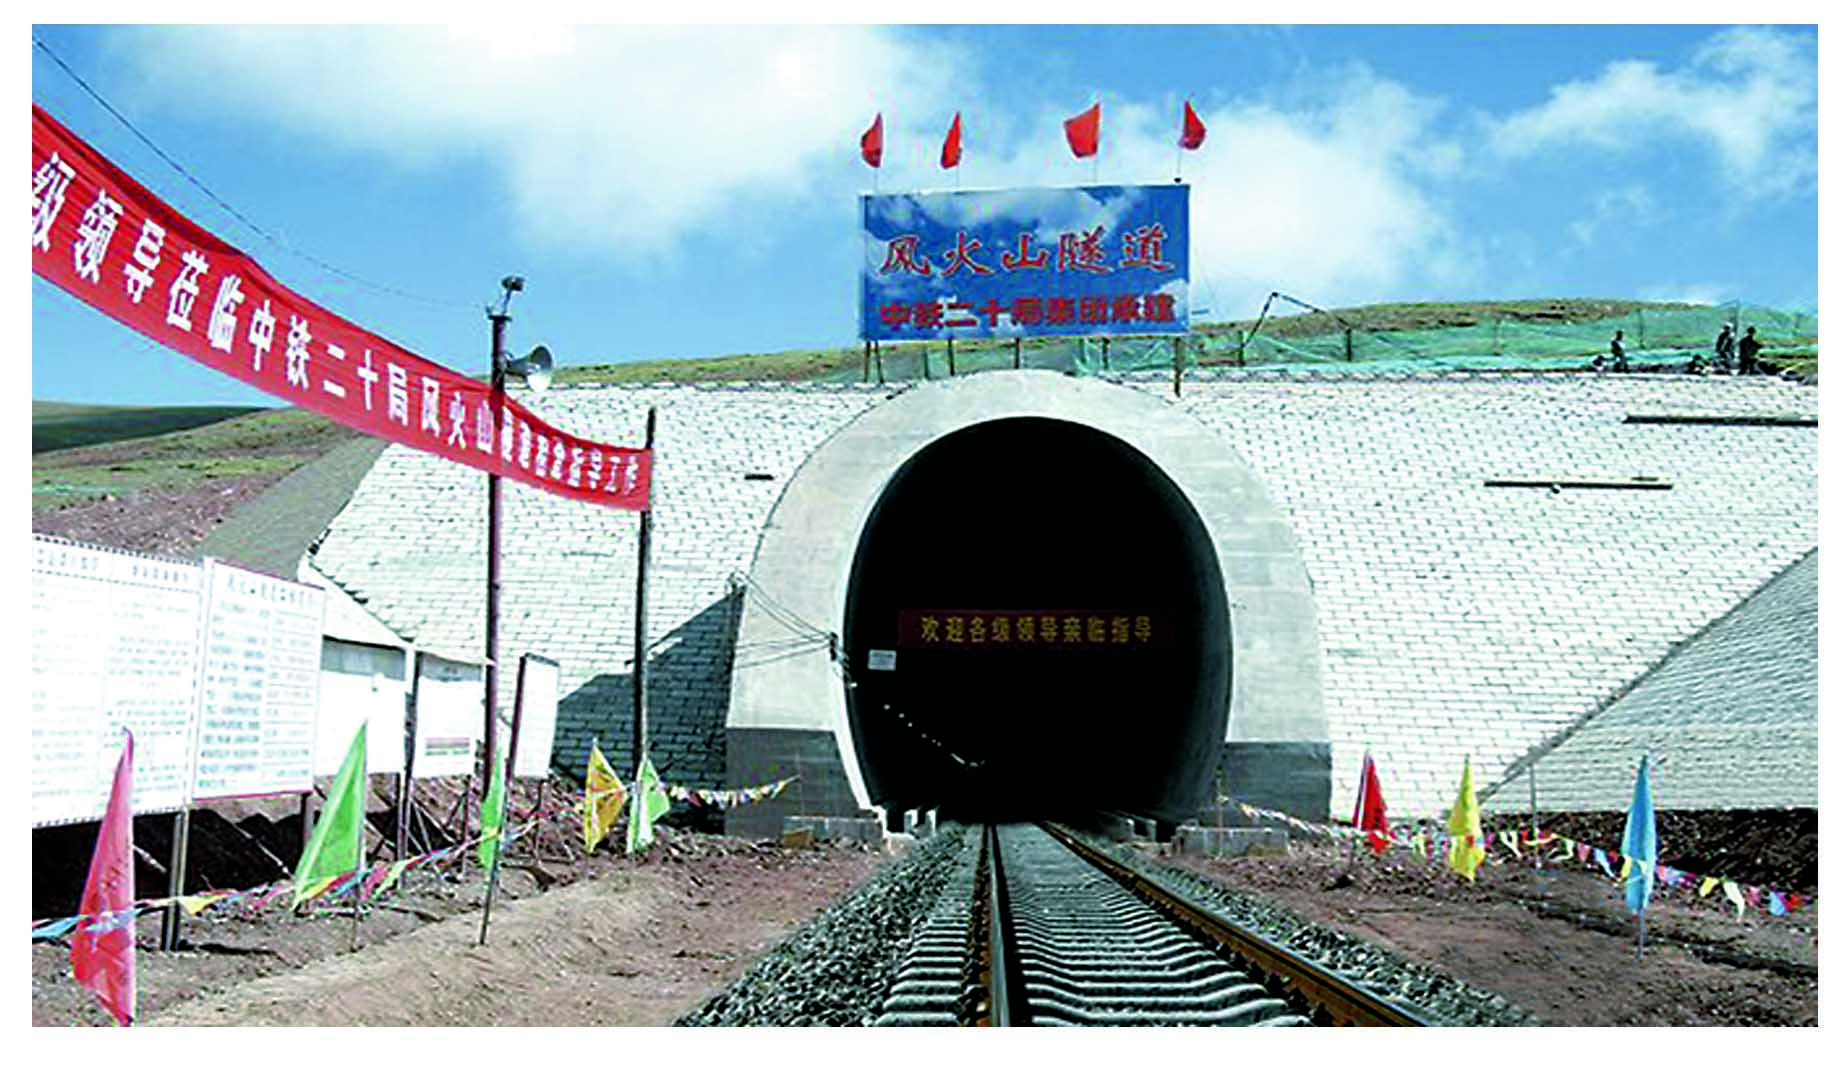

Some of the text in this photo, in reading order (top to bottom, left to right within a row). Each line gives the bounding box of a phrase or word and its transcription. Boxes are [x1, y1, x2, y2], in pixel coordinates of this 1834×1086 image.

[879, 223, 1175, 277] 风火山隧道
[879, 293, 1176, 328] 中铁二十局集团承建
[920, 614, 1152, 644] 欢迎各级领导亲临指导
